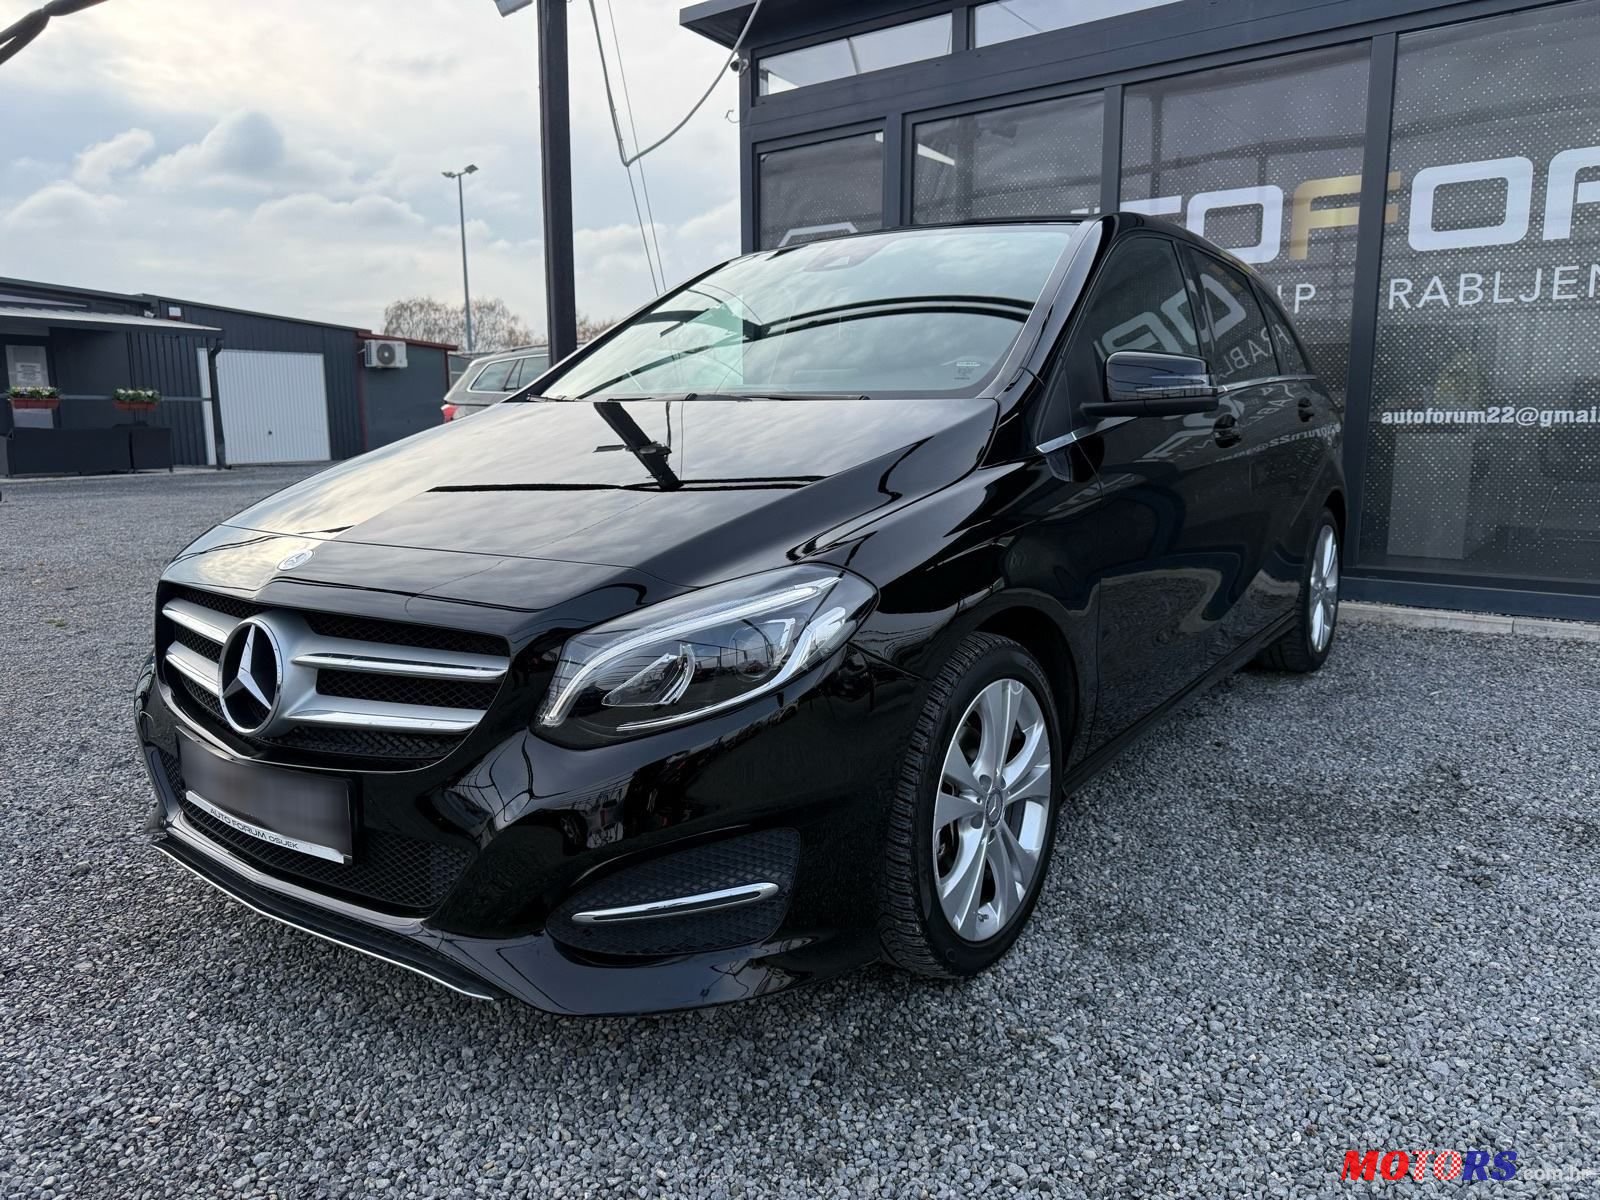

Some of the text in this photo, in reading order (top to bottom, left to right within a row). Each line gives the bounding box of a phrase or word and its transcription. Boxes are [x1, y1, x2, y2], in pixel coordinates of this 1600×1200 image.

[210, 808, 299, 850] AUTO FORUM OSIJEK
